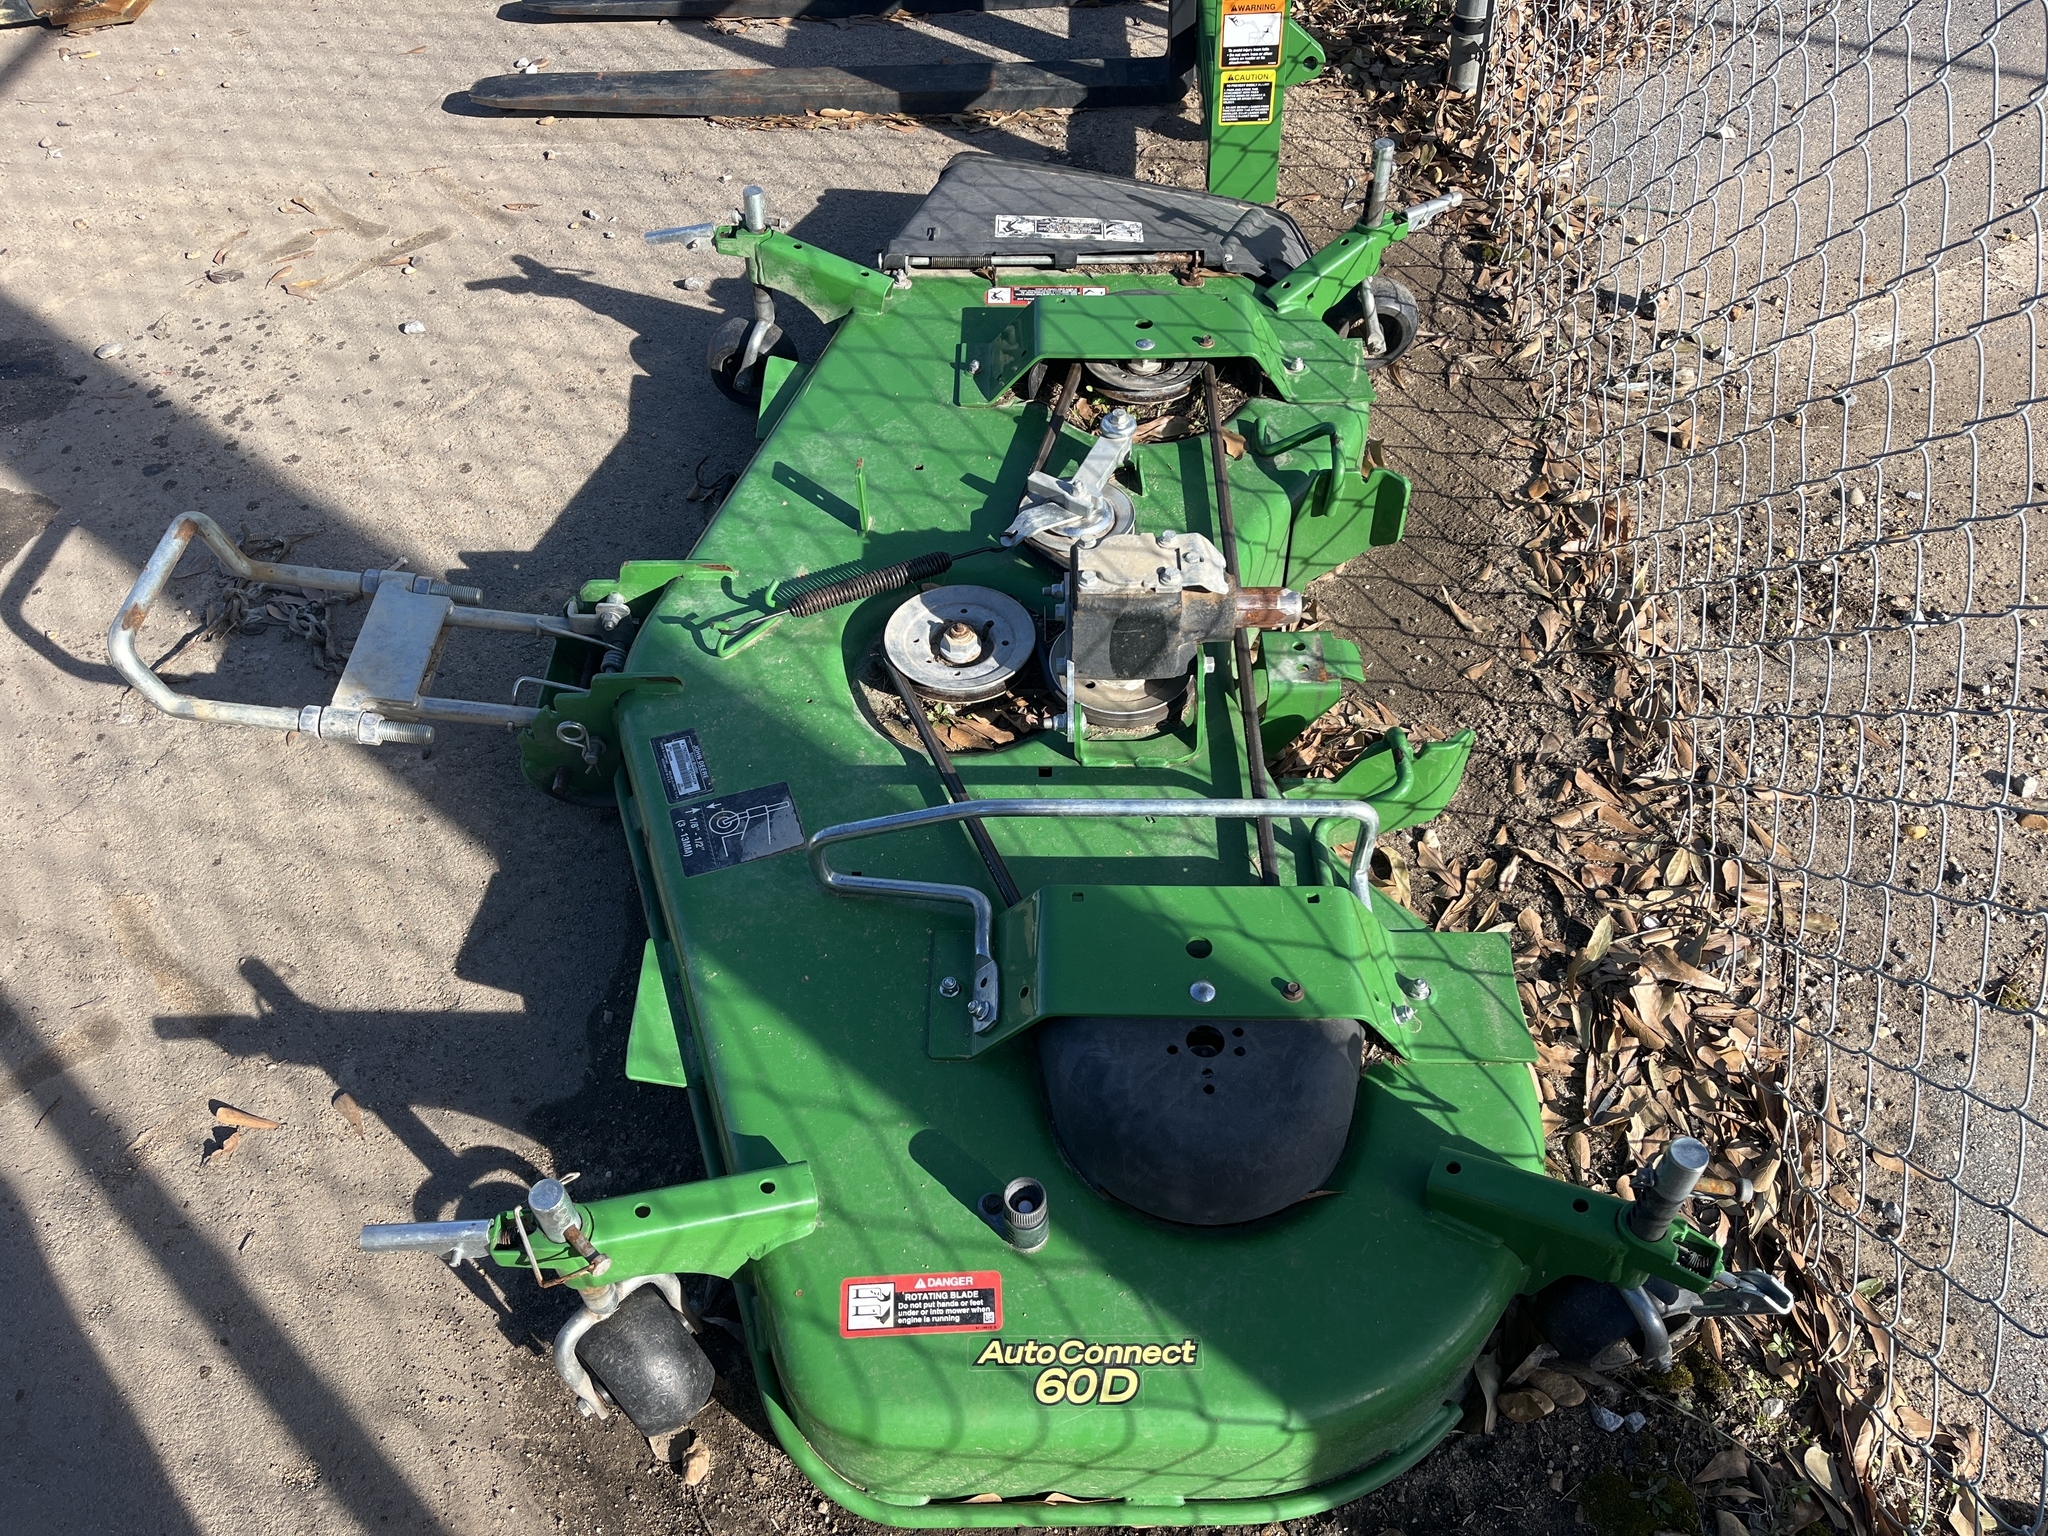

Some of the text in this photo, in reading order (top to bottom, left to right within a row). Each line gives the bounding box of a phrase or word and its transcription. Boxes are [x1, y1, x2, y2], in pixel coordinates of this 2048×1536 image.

[1237, 3, 1276, 12] WARNING
[1234, 73, 1269, 81] CAUTION
[692, 744, 709, 780] JOHN DEERE
[675, 819, 686, 828] (3
[680, 832, 693, 857] 13MM)
[927, 1276, 974, 1288] DANGER
[904, 1290, 979, 1301] ROTATING BLADE
[923, 1302, 935, 1310] put
[936, 1300, 959, 1308] hands
[898, 1309, 919, 1317] under
[897, 1316, 922, 1325] engine
[931, 1315, 960, 1324] running
[974, 1338, 1198, 1366] AutoConnect
[1034, 1366, 1140, 1405] 60D
